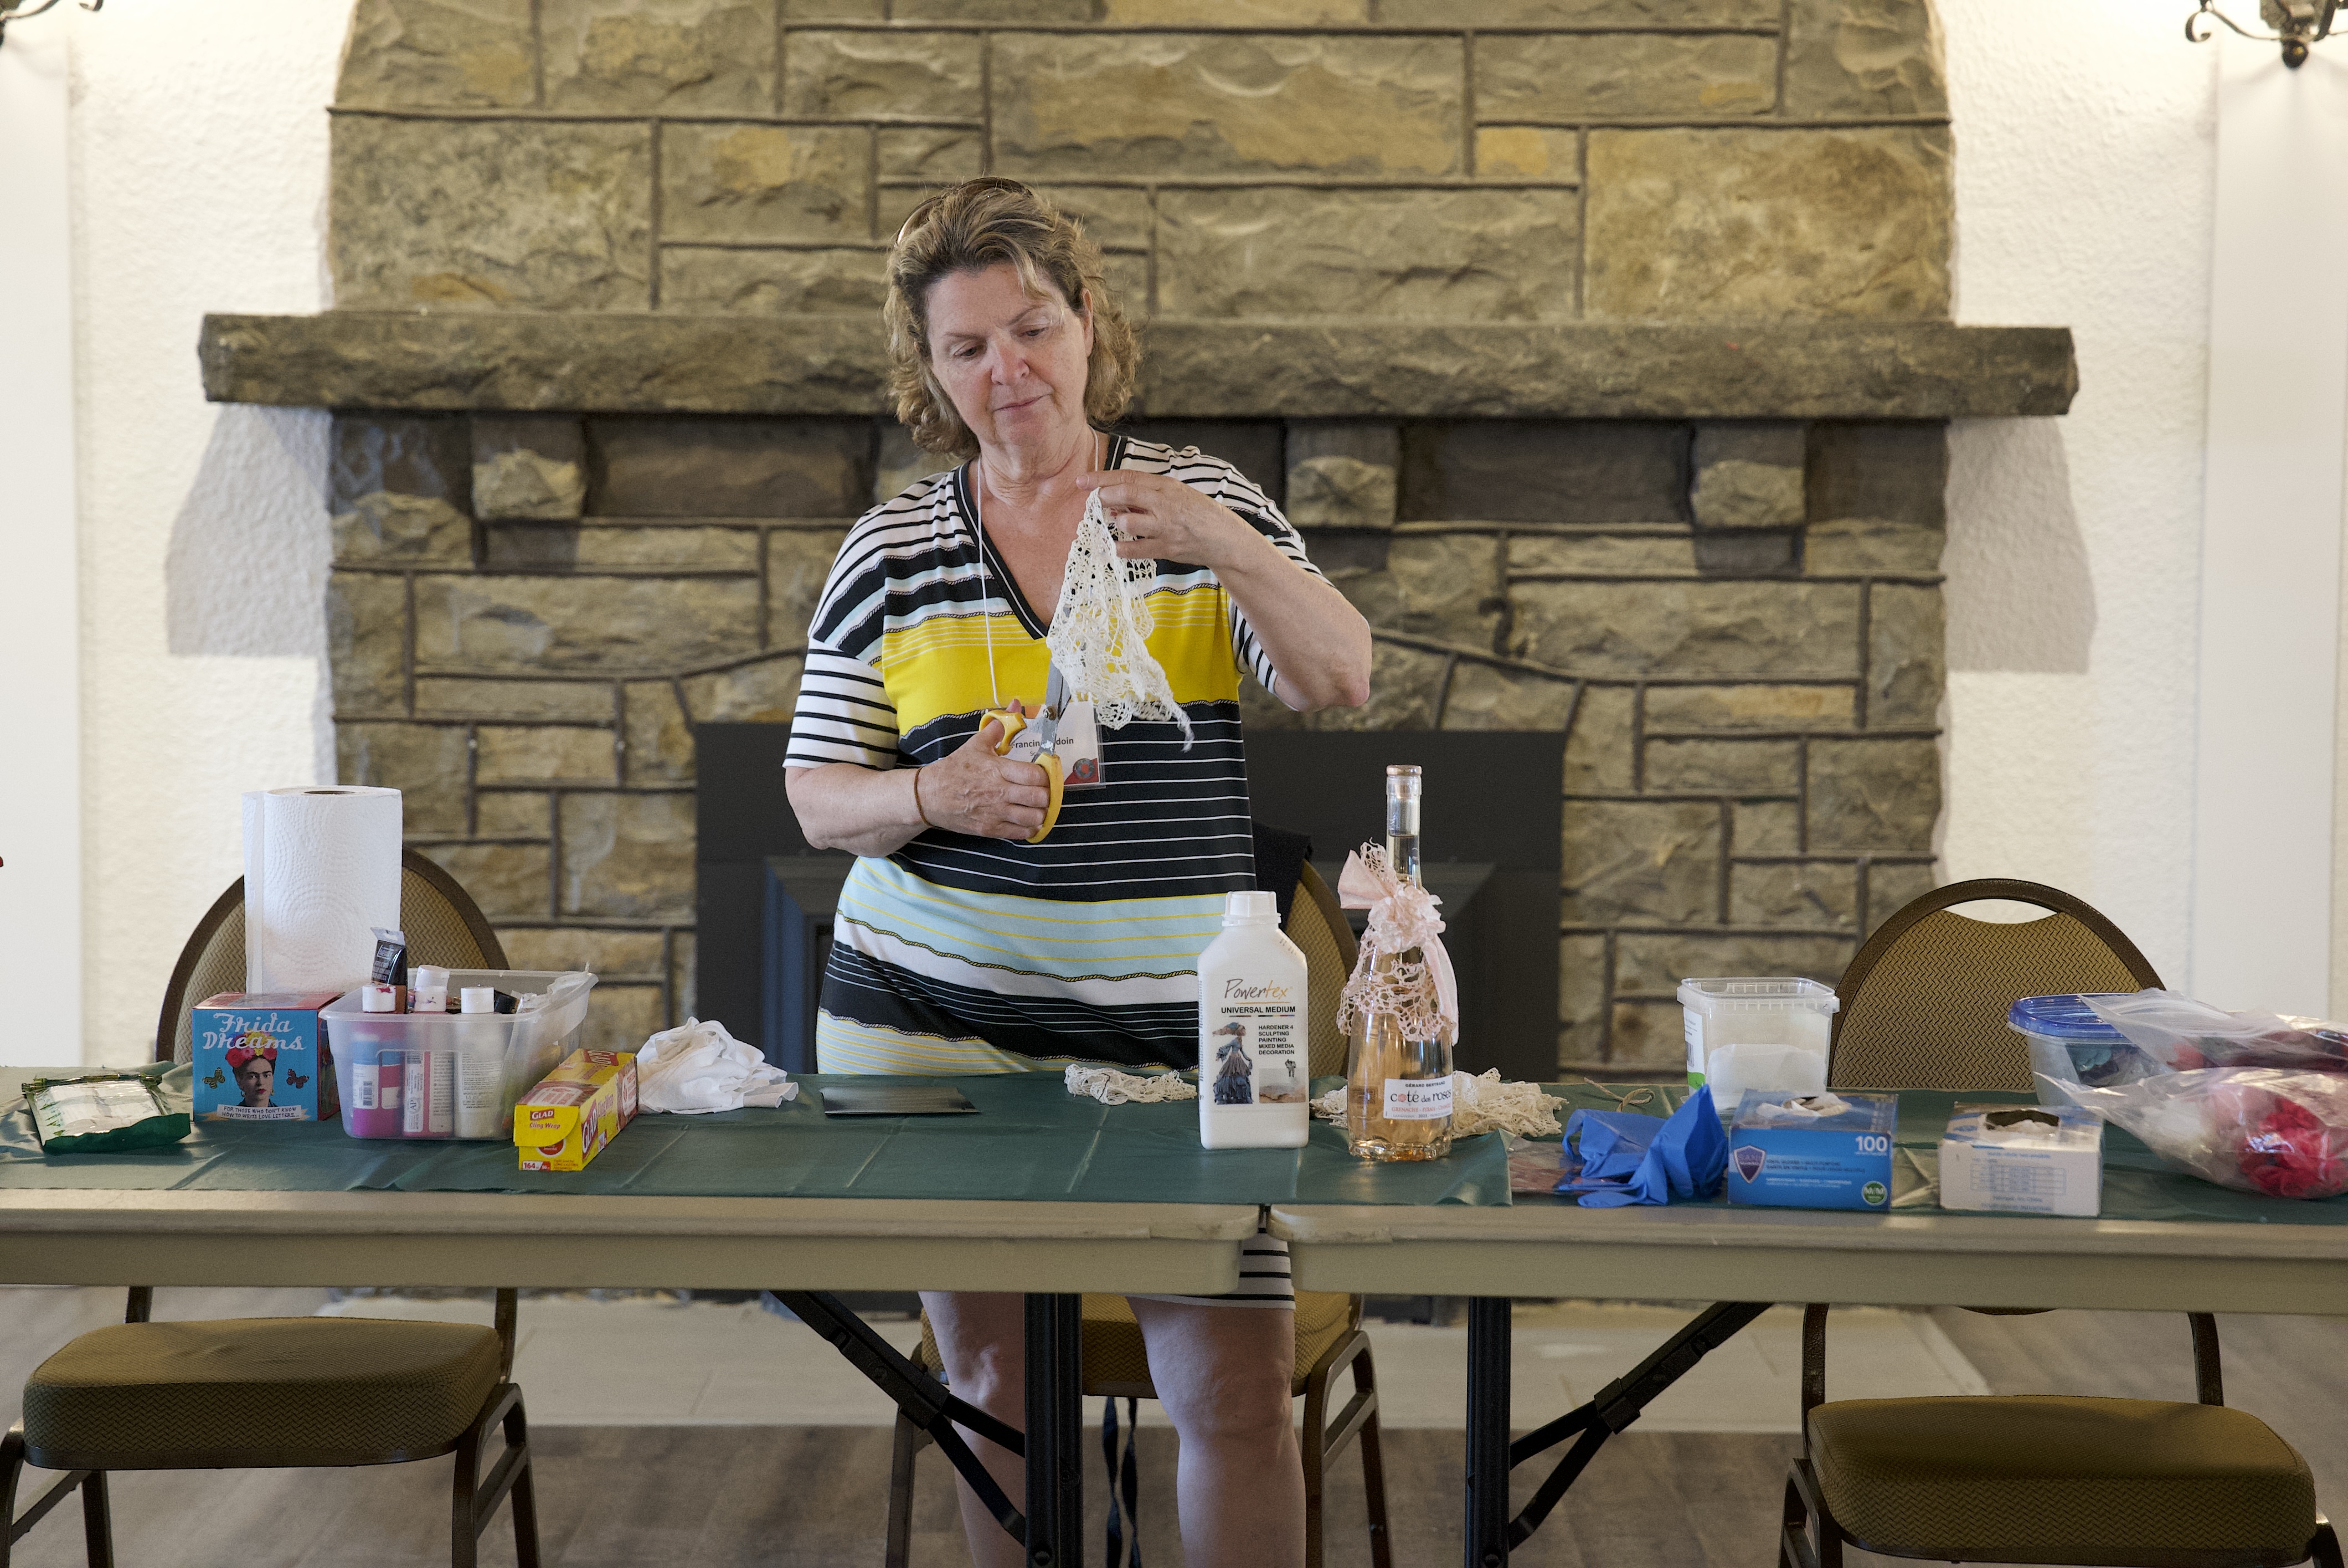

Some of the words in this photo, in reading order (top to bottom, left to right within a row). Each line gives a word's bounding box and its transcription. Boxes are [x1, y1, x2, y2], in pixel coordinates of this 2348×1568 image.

[1224, 978, 1289, 1000] Powertex
[213, 1012, 294, 1033] Frida
[203, 1031, 306, 1050] Dreams
[532, 1110, 554, 1120] GLAD
[583, 1108, 598, 1154] GLAD
[1856, 1136, 1888, 1152] 100
